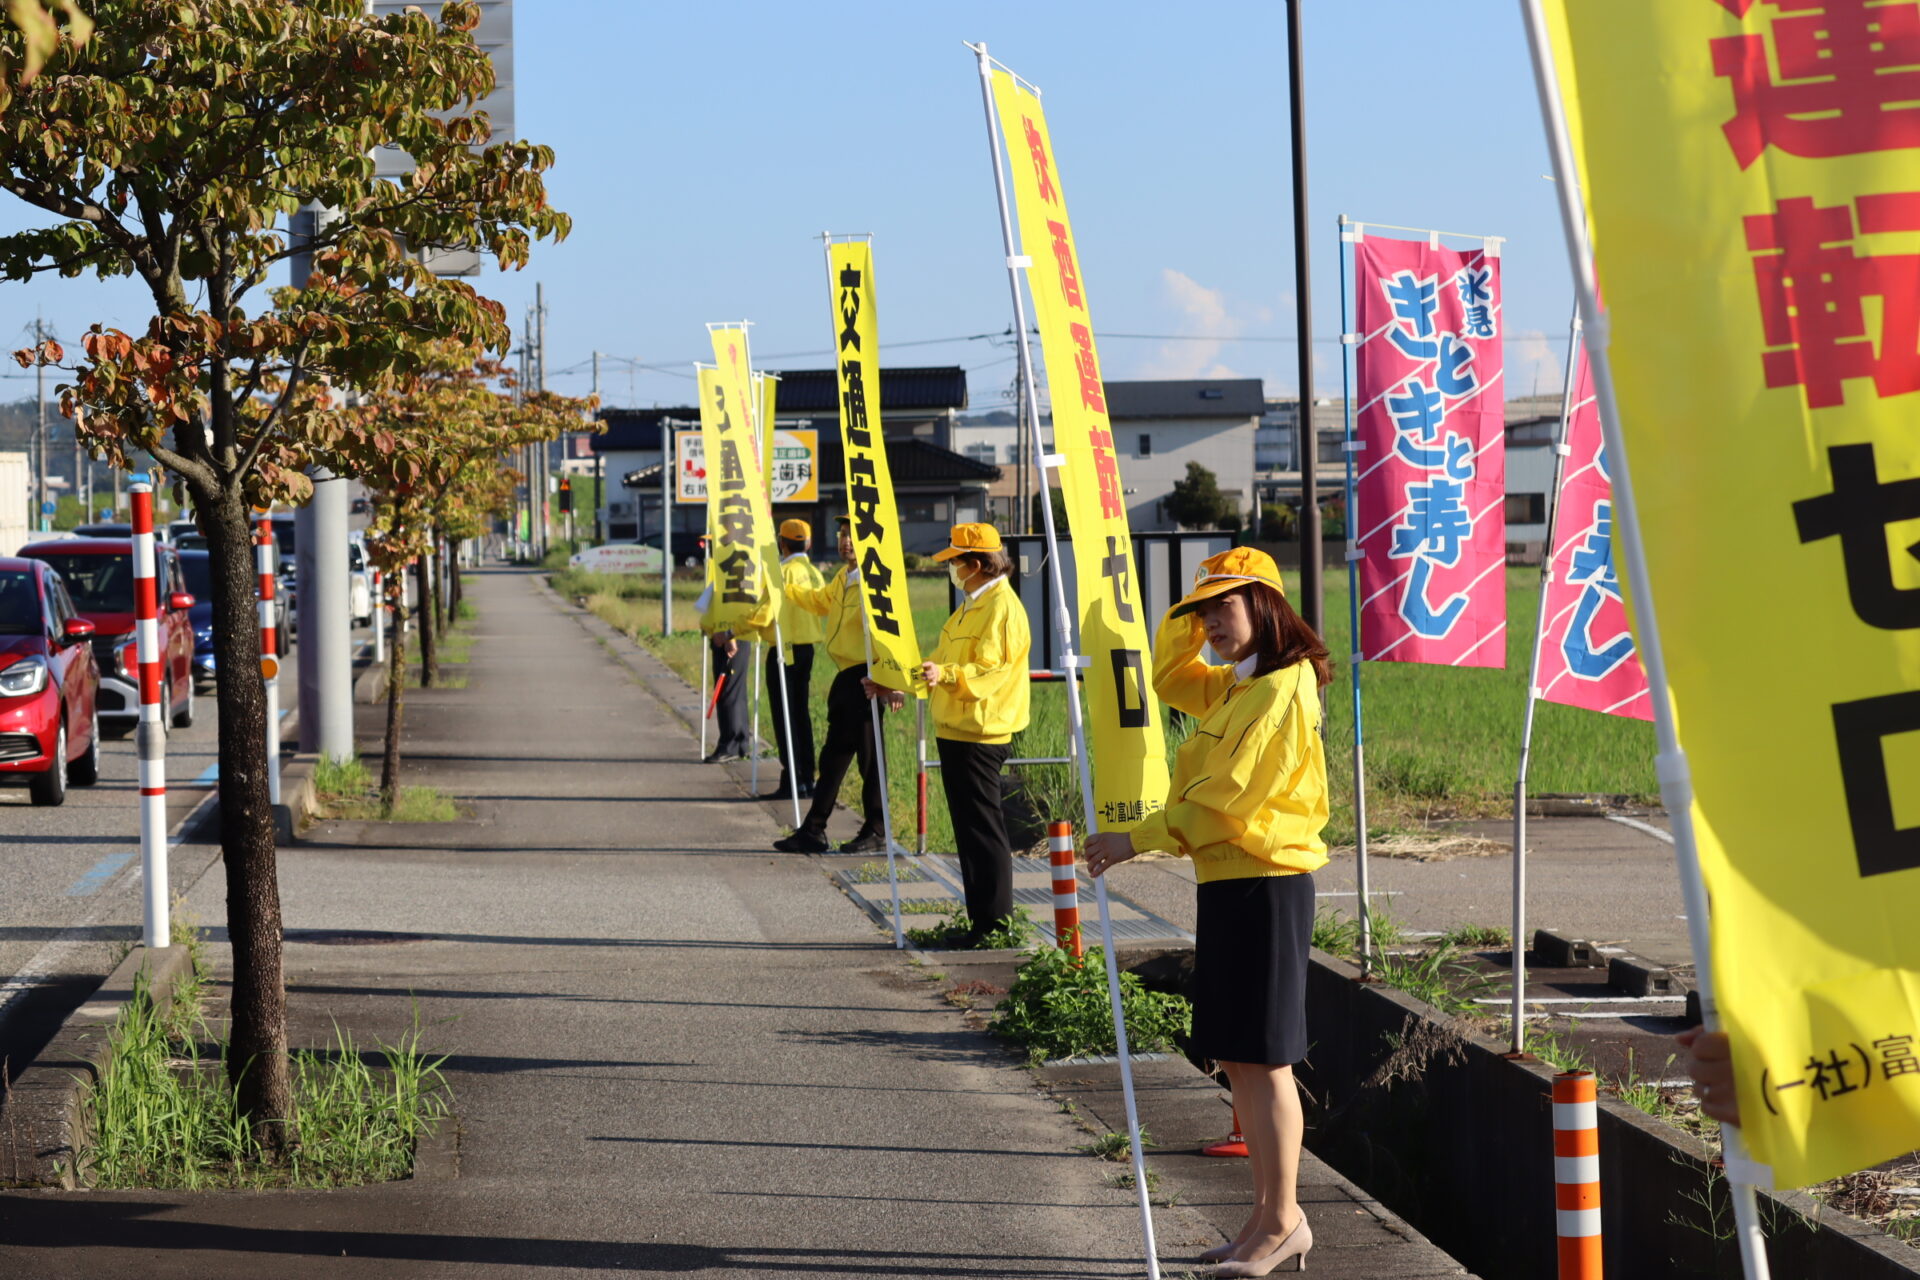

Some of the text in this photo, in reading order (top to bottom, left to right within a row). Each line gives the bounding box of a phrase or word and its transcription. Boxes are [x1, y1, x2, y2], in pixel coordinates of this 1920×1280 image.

[839, 262, 900, 638] 交通安全
[1379, 269, 1481, 640] きときと寿し
[1455, 265, 1497, 339] 氷見
